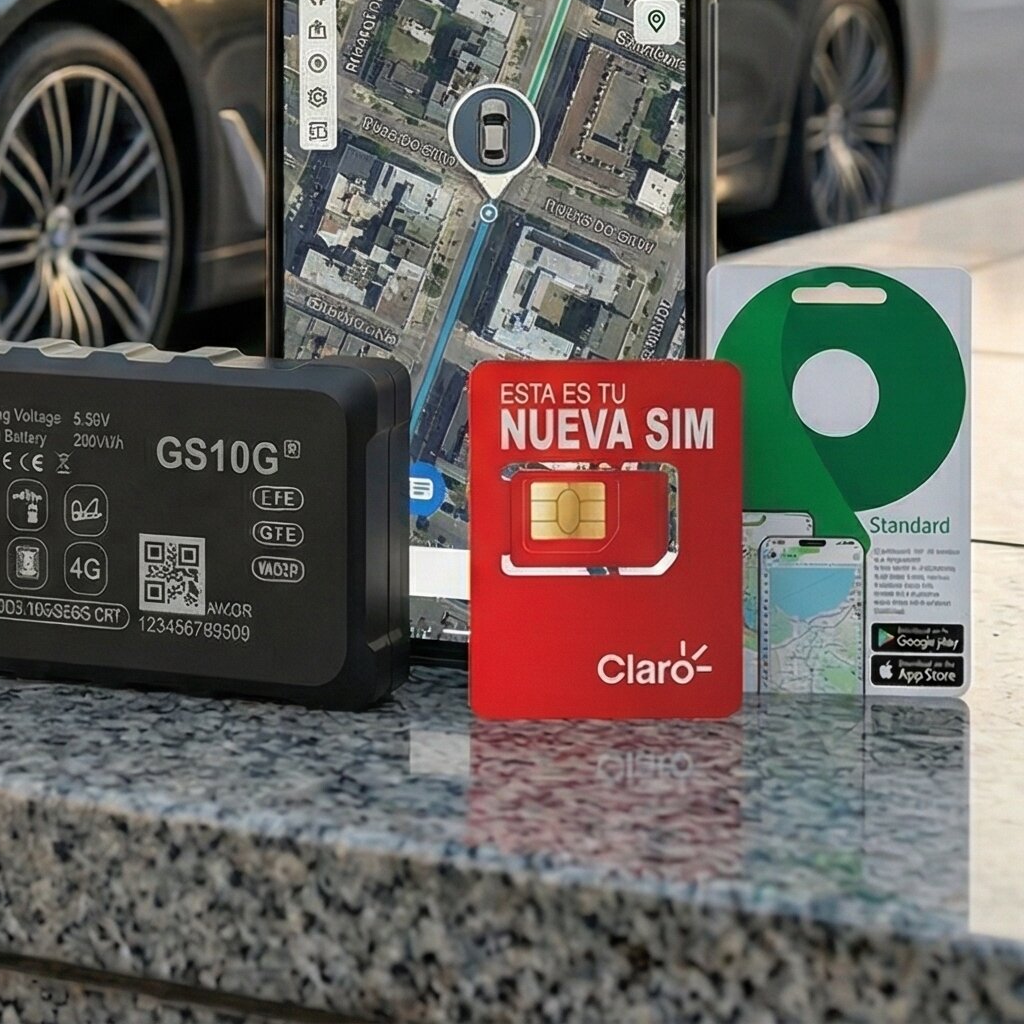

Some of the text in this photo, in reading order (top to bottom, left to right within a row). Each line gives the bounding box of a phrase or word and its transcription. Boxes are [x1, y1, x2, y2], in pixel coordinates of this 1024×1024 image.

[500, 382, 626, 405] ESTA ES TU
[14, 408, 62, 427] Voltage
[500, 407, 714, 450] NUEVA SIM
[156, 435, 278, 475] GS10G
[870, 516, 950, 533] Standard
[69, 556, 101, 580] 4G
[597, 645, 706, 684] Claro
[898, 667, 957, 684] App Store
